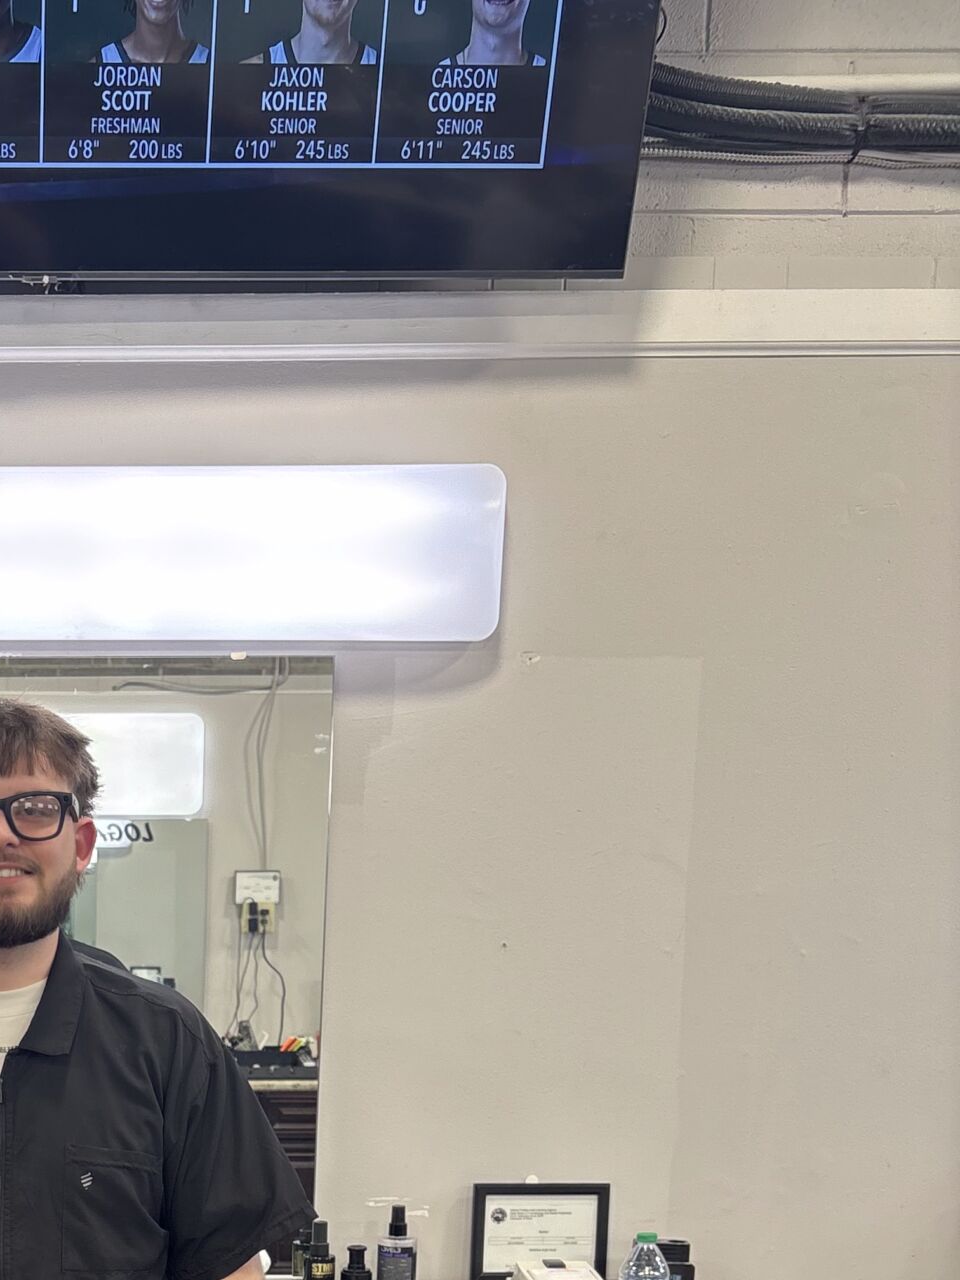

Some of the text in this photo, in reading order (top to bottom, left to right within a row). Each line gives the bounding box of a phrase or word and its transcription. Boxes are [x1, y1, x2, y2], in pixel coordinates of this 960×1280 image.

[93, 65, 162, 87] JORDAN
[269, 66, 324, 88] JAXON
[431, 67, 498, 89] CARSON
[101, 90, 152, 111] SCOTT
[261, 90, 328, 112] KOHLER
[428, 91, 497, 113] COOPER
[91, 117, 160, 134] FRESHMAN
[269, 117, 317, 135] SENIOR
[436, 118, 484, 135] SENIOR
[68, 139, 183, 159] 6'8" 200 LBS
[234, 139, 349, 160] 6'10" 245 LBS
[400, 140, 515, 160] 6'11" 245 LBS
